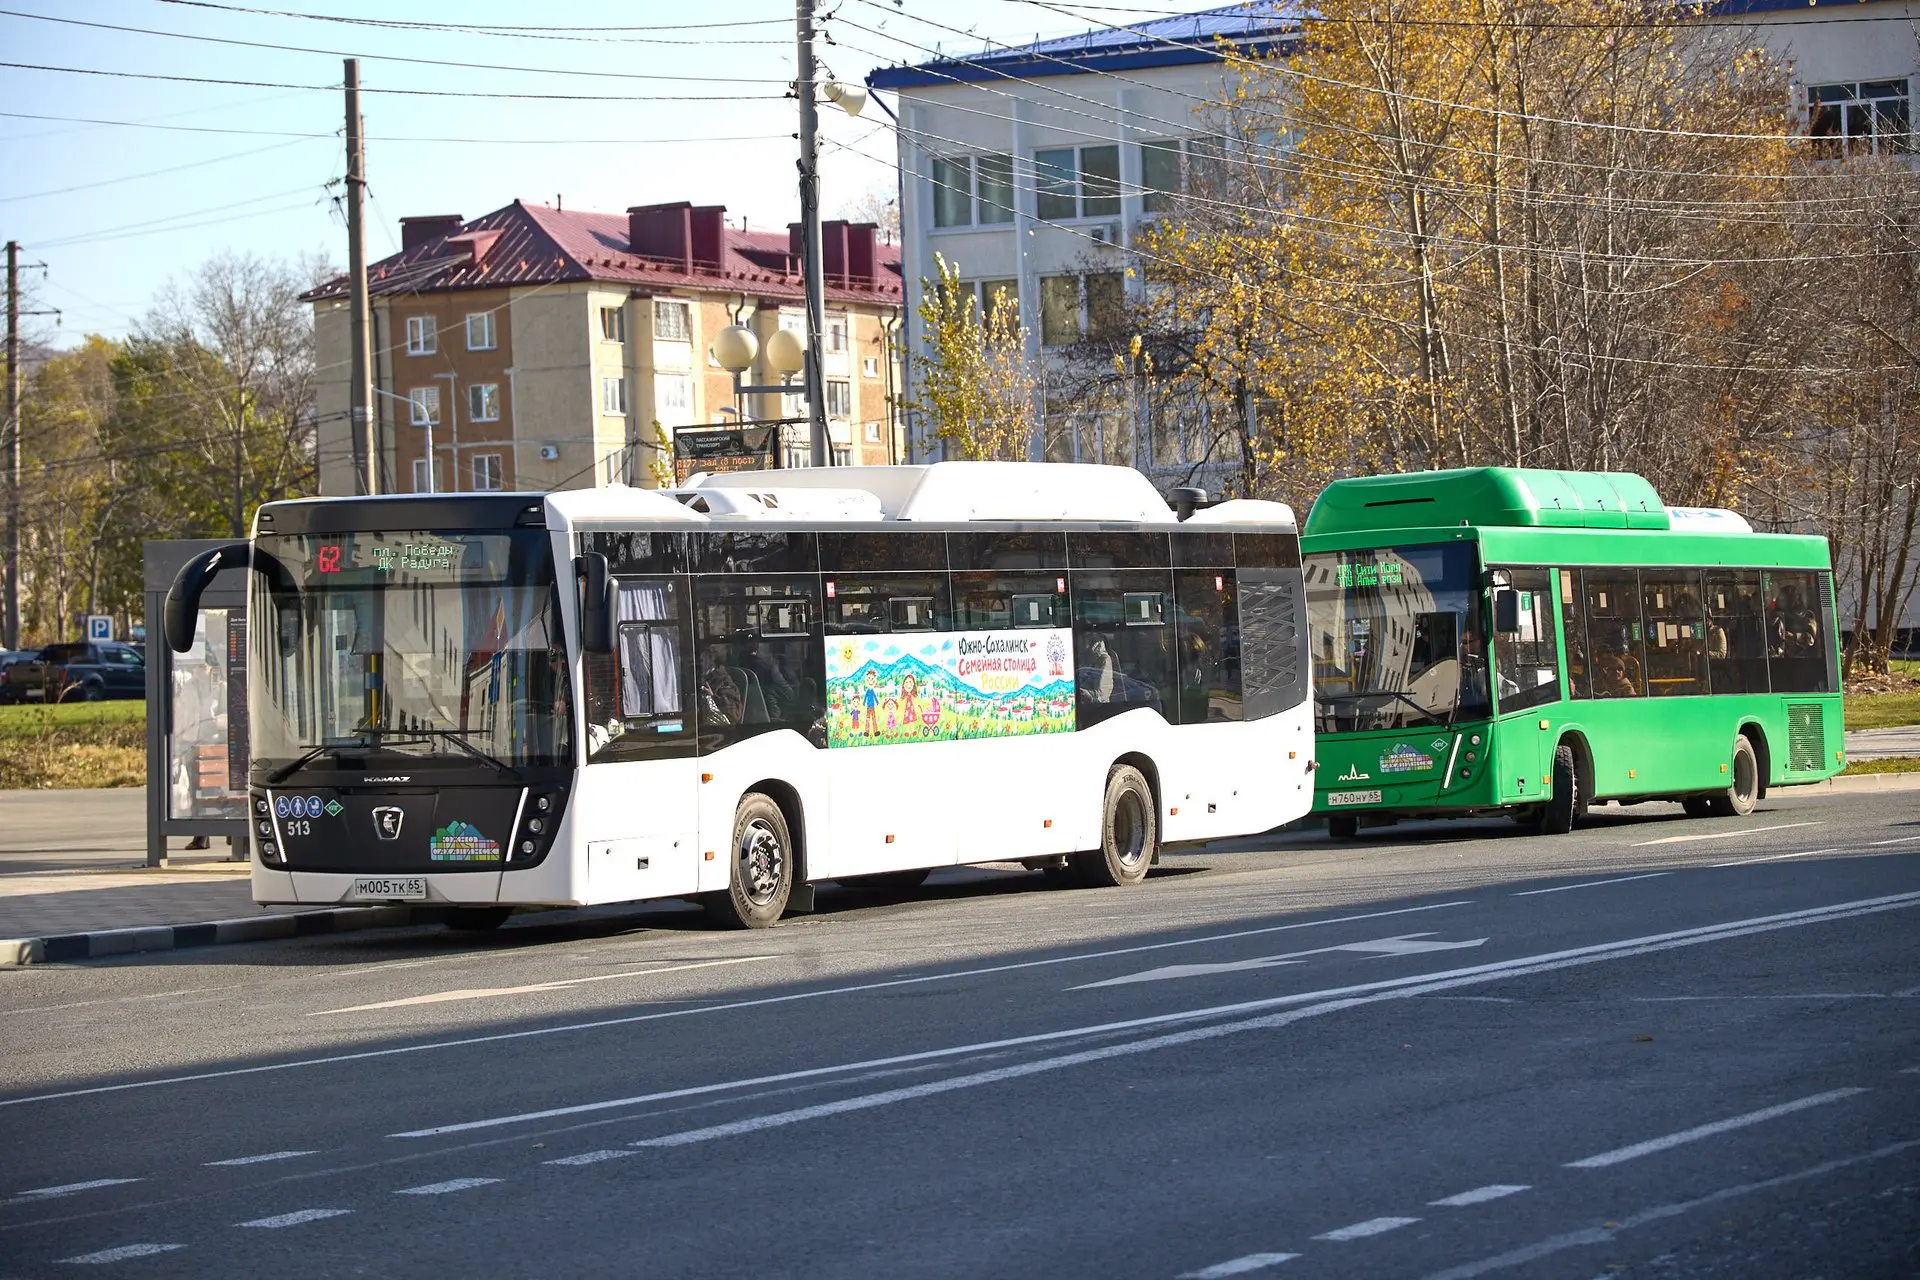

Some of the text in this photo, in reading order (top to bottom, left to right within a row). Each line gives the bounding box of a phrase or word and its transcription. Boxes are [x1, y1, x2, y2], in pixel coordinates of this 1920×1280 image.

[373, 544, 453, 557] пл. Победы
[319, 546, 341, 573] 62
[378, 557, 450, 570] ДК Радуга
[95, 620, 107, 638] P
[958, 655, 1037, 676] Семейная столица
[981, 673, 1019, 690] России
[1369, 791, 1379, 799] 65
[287, 820, 311, 836] 513
[359, 880, 420, 893] М005ТК 65
